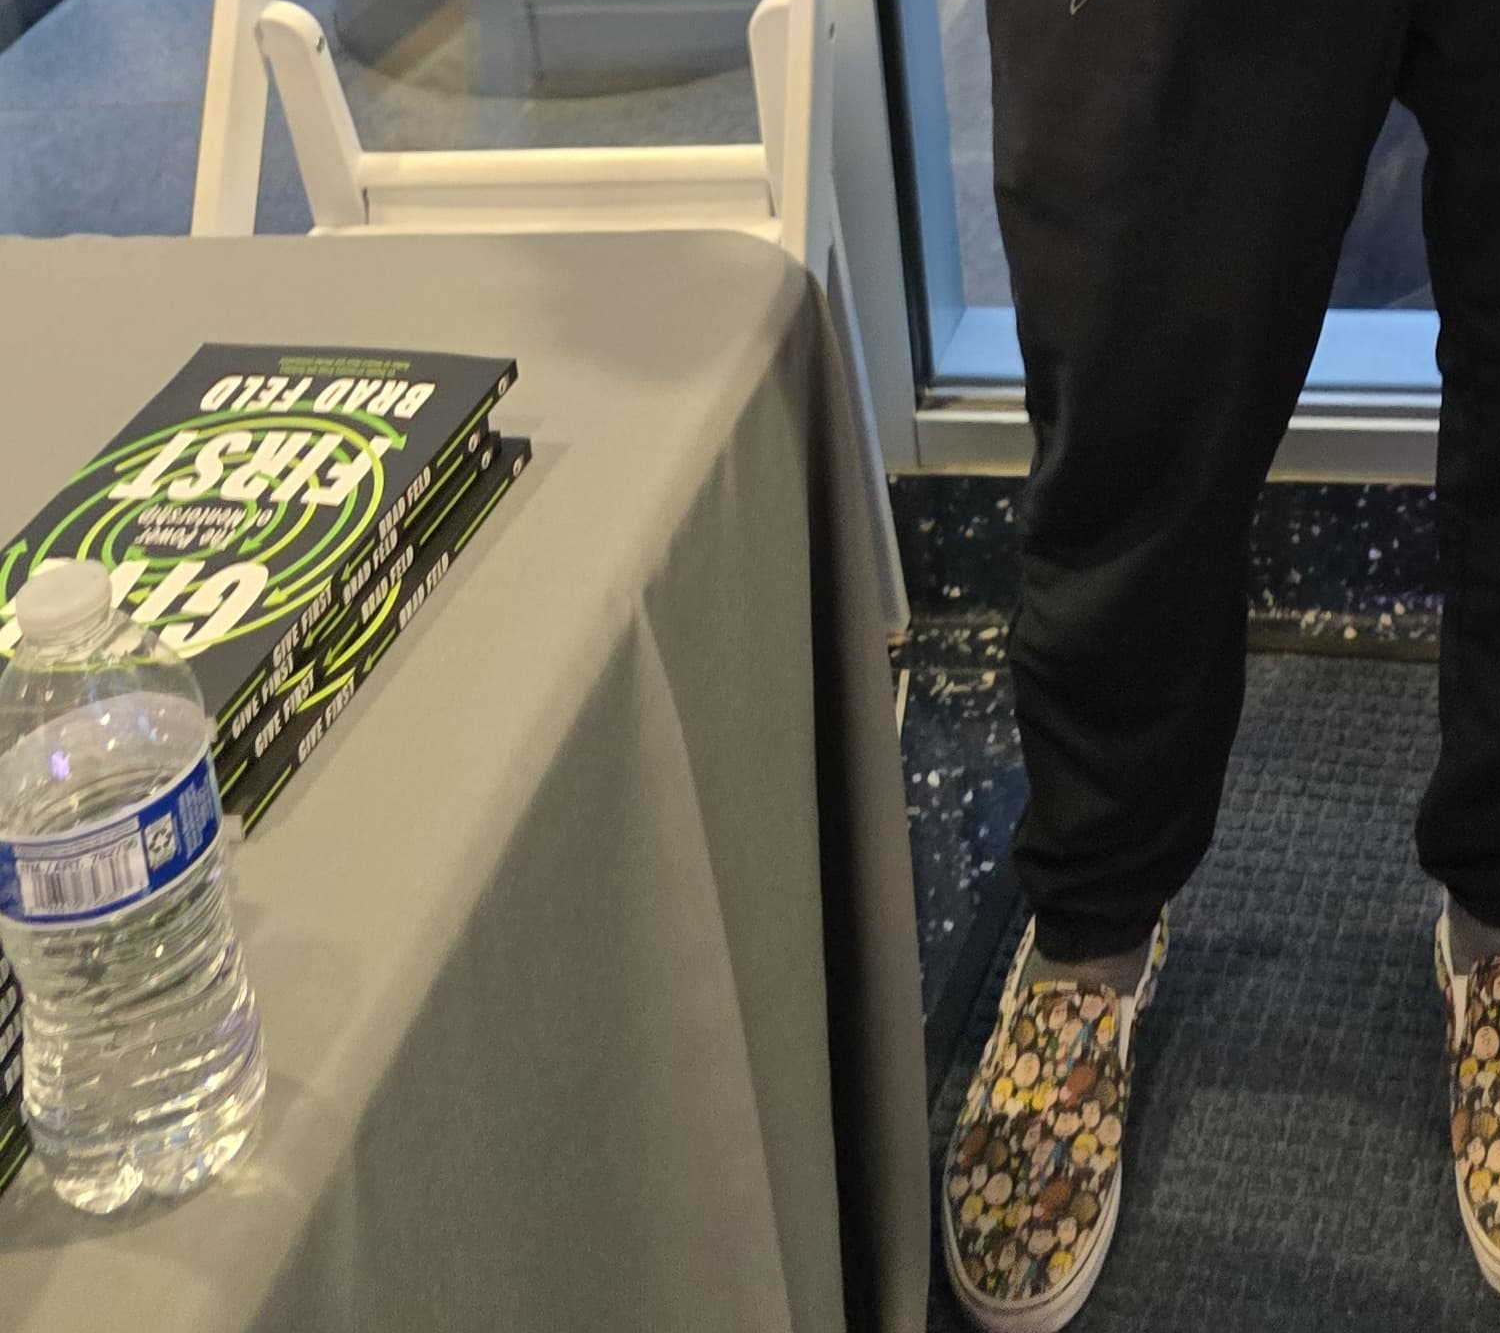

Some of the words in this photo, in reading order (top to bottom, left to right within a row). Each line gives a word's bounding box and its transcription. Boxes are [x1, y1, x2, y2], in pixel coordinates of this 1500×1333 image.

[200, 374, 314, 413] FELD
[313, 378, 436, 420] BRAD
[108, 428, 393, 507] FIRST
[133, 525, 198, 551] Power
[199, 527, 238, 552] The
[243, 507, 273, 528] of
[273, 623, 300, 667] GIVE
[301, 585, 333, 633] FIRST
[379, 497, 405, 541] BRAD
[406, 466, 431, 505] FELD
[232, 694, 261, 739] GIVE
[262, 657, 294, 704] FIRST
[342, 562, 372, 606] BRAD
[372, 524, 399, 571] FELD
[255, 710, 283, 757] GIVE
[283, 669, 315, 722] FIRST
[361, 576, 389, 624] BRAD
[389, 544, 414, 586] FELD
[298, 717, 323, 764] GIVE
[325, 674, 356, 729] FIRST
[399, 584, 425, 632] BRAD
[426, 552, 449, 593] FELD
